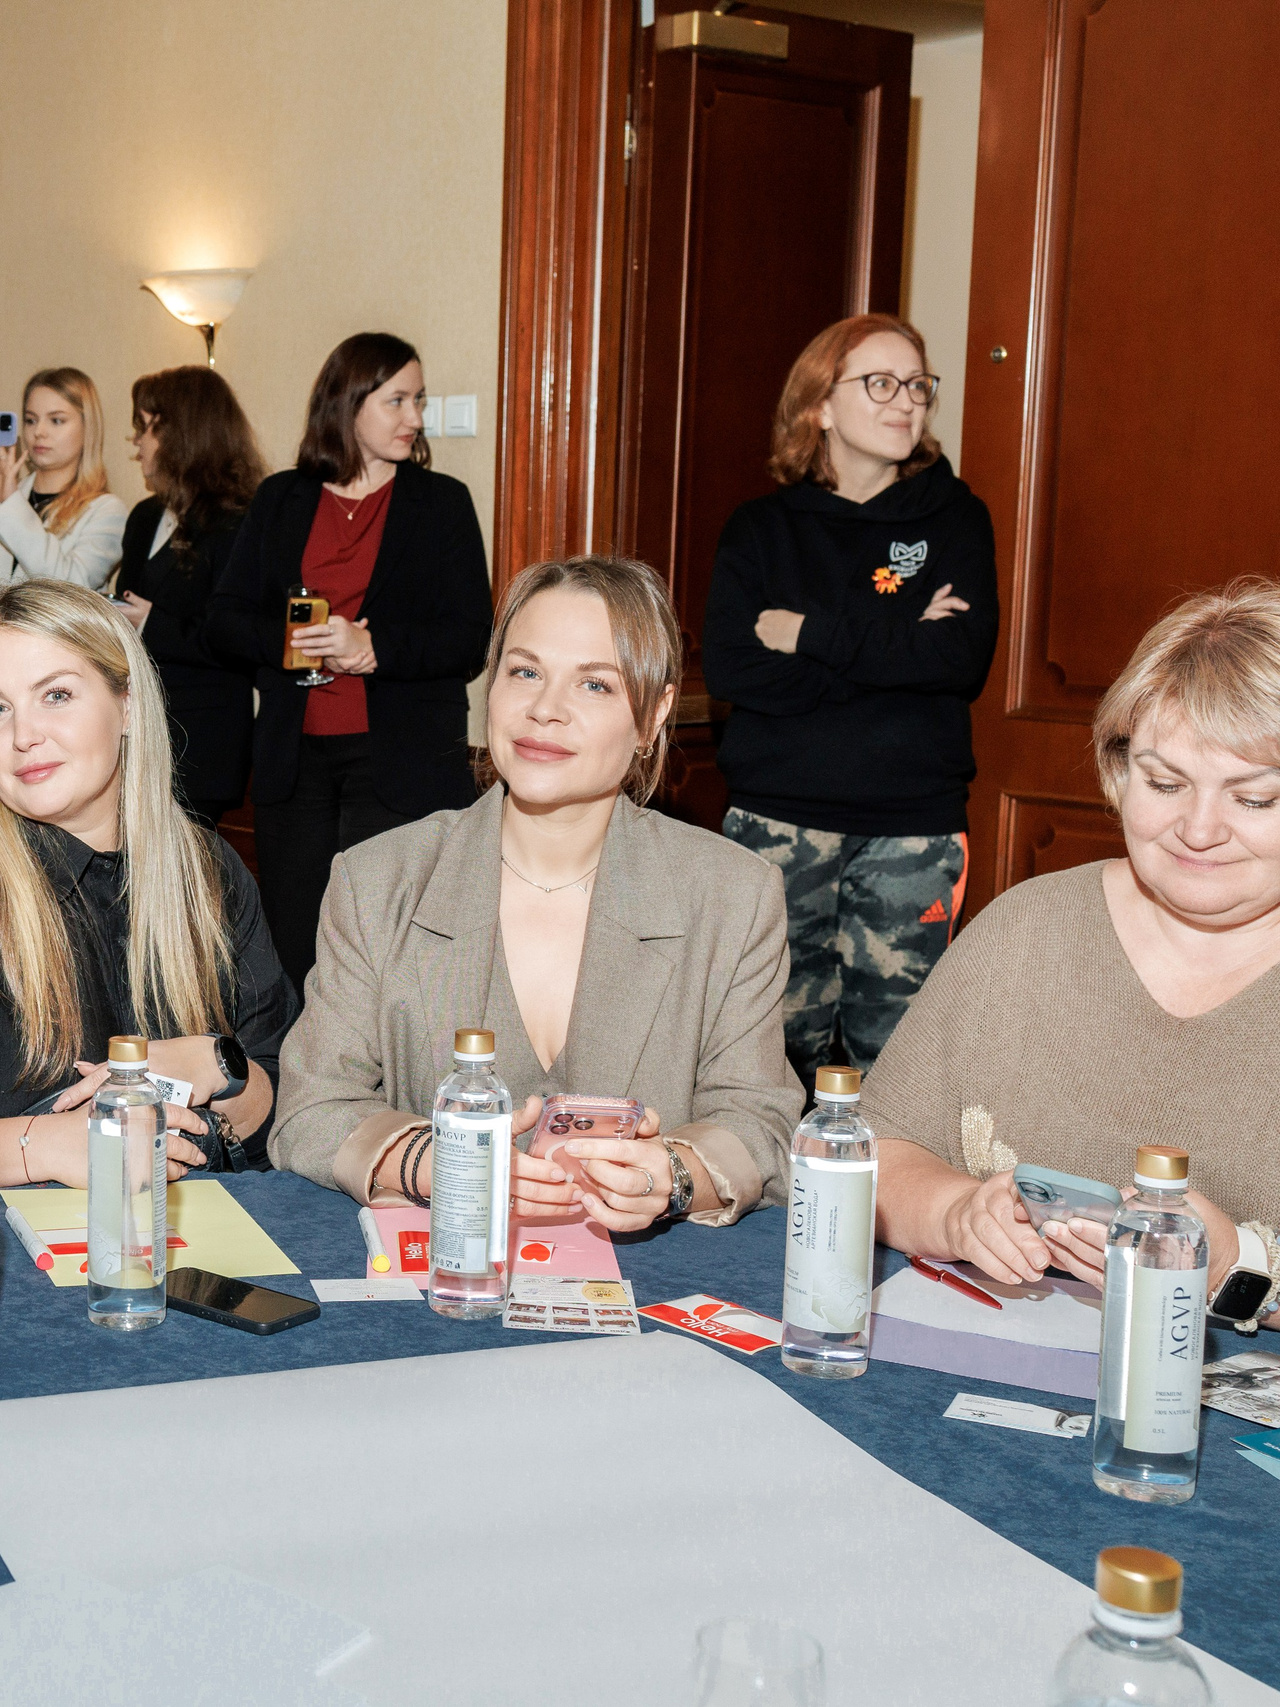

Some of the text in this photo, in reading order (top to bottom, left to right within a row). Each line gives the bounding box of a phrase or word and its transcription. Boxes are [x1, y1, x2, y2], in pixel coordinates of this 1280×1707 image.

[441, 1130, 467, 1142] AGVP
[791, 1178, 806, 1246] AGVP
[404, 1242, 423, 1260] Hello
[679, 1317, 730, 1337] Hello
[1169, 1286, 1192, 1360] AGVP
